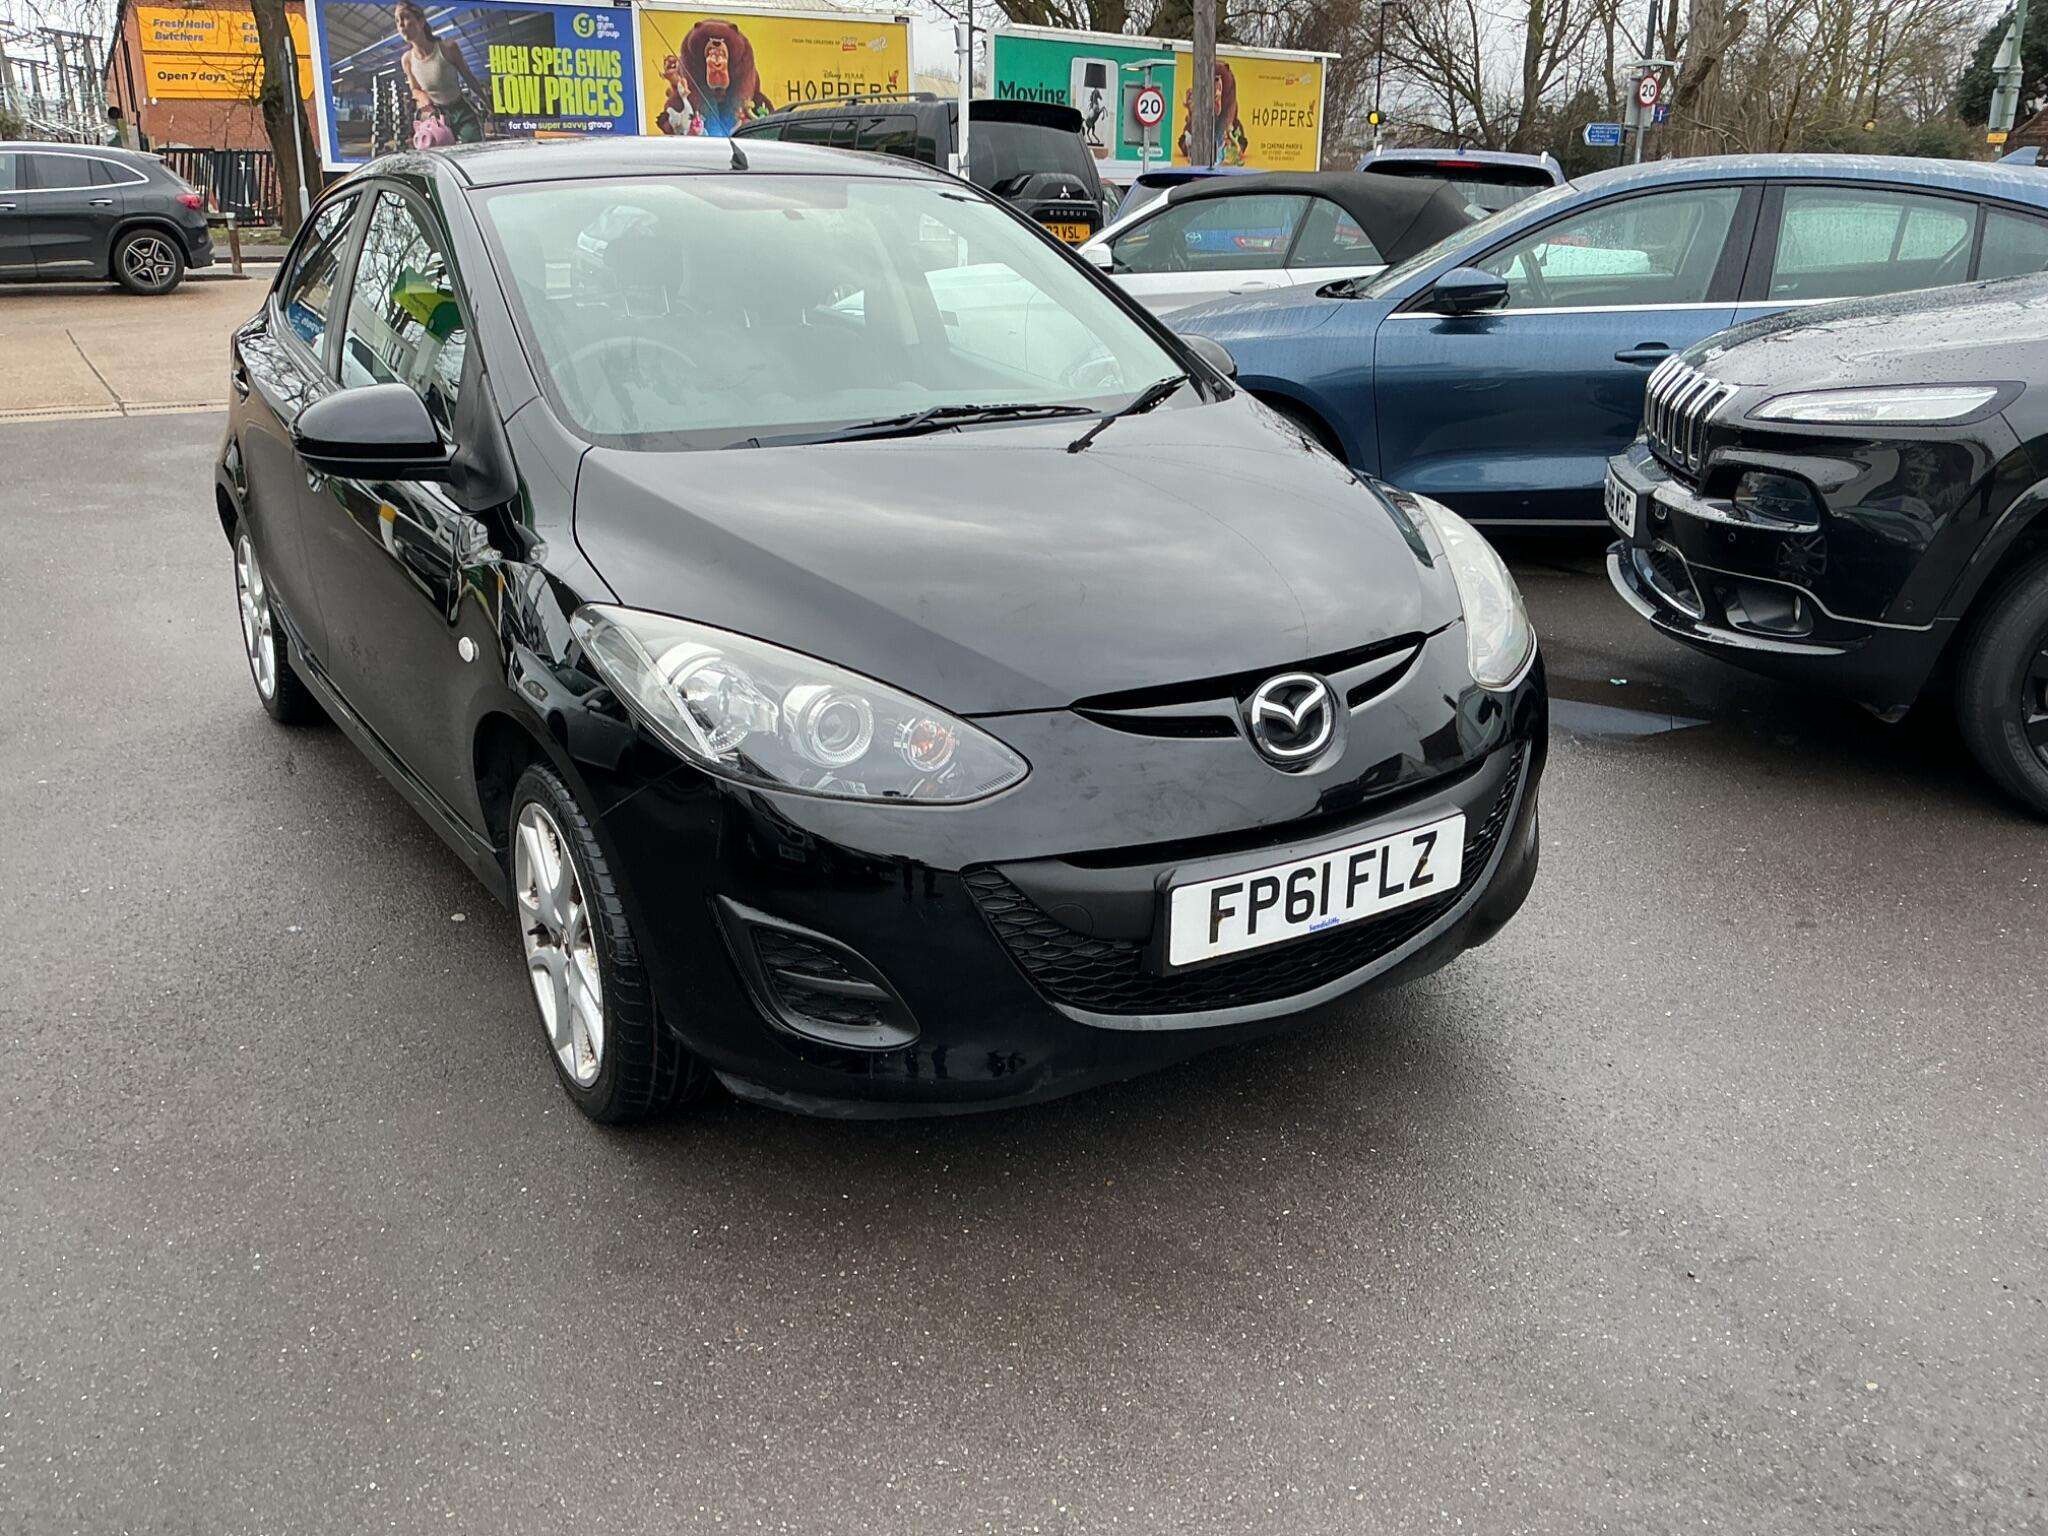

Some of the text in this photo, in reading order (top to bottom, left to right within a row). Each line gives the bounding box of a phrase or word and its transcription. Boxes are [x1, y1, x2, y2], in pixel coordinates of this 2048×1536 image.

[153, 19, 215, 29] Fresh Halal
[597, 14, 609, 22] the
[597, 22, 614, 30] gym
[154, 31, 204, 42] Butchers
[597, 30, 620, 39] group
[489, 44, 622, 78] HIGH SPEC GYMS
[157, 72, 188, 82] Open
[190, 72, 196, 80] 7
[199, 72, 226, 83] days
[491, 75, 624, 117] LOW PRICES
[787, 80, 898, 103] HOPPERS
[998, 80, 1066, 105] Moving
[1642, 84, 1656, 97] 20
[1139, 99, 1160, 114] 20
[1252, 107, 1314, 128] HOPPERS
[508, 121, 613, 131] for the super savvy group
[1062, 224, 1080, 239] VSL
[1209, 830, 1438, 944] FP61 FLZ
